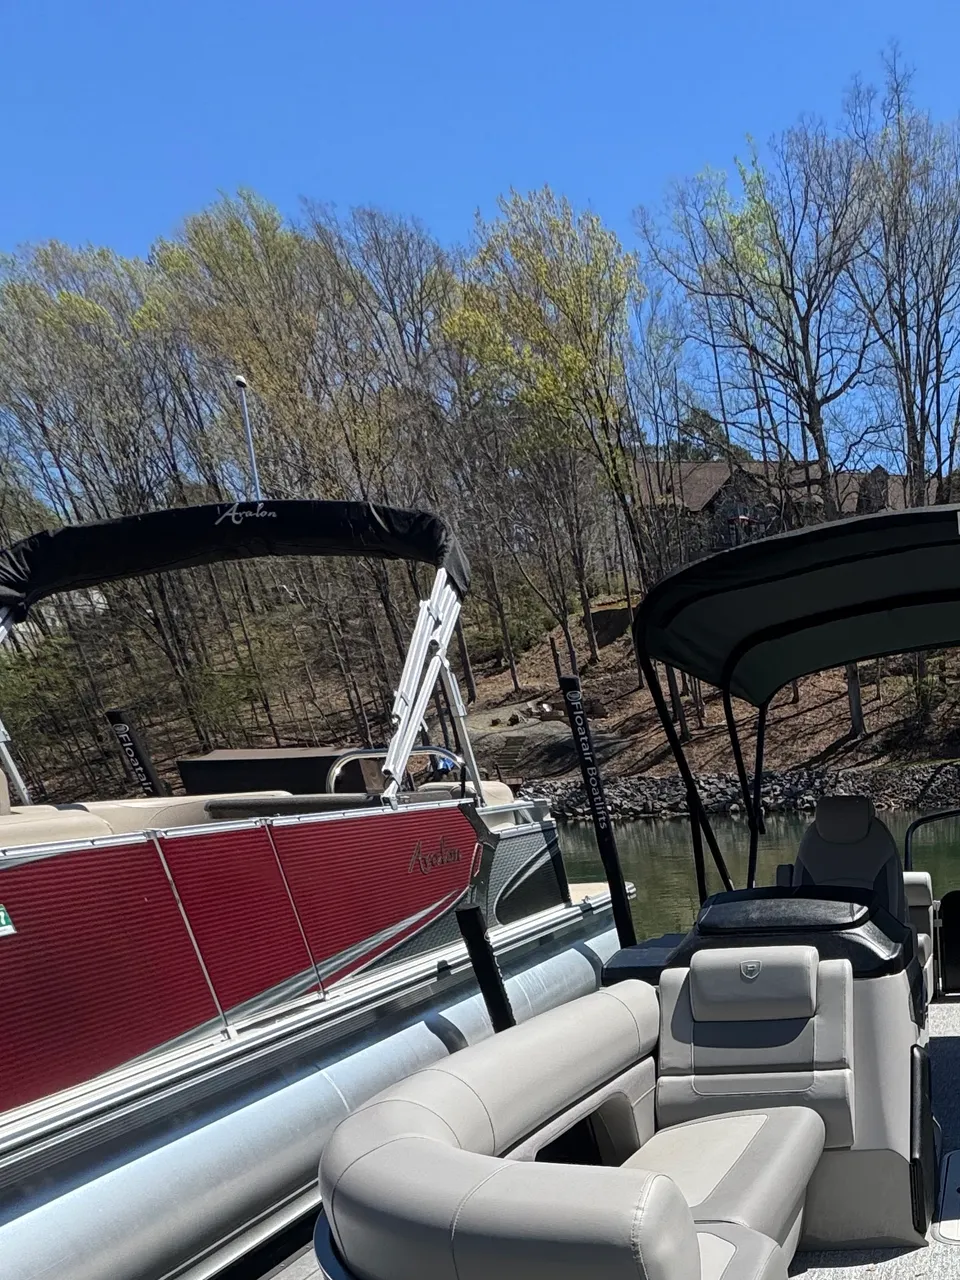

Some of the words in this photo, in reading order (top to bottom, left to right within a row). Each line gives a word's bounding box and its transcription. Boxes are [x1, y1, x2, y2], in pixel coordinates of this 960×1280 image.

[118, 733, 153, 793] Floatair
[571, 701, 593, 763] Floatair
[587, 766, 607, 830] Boatlifts
